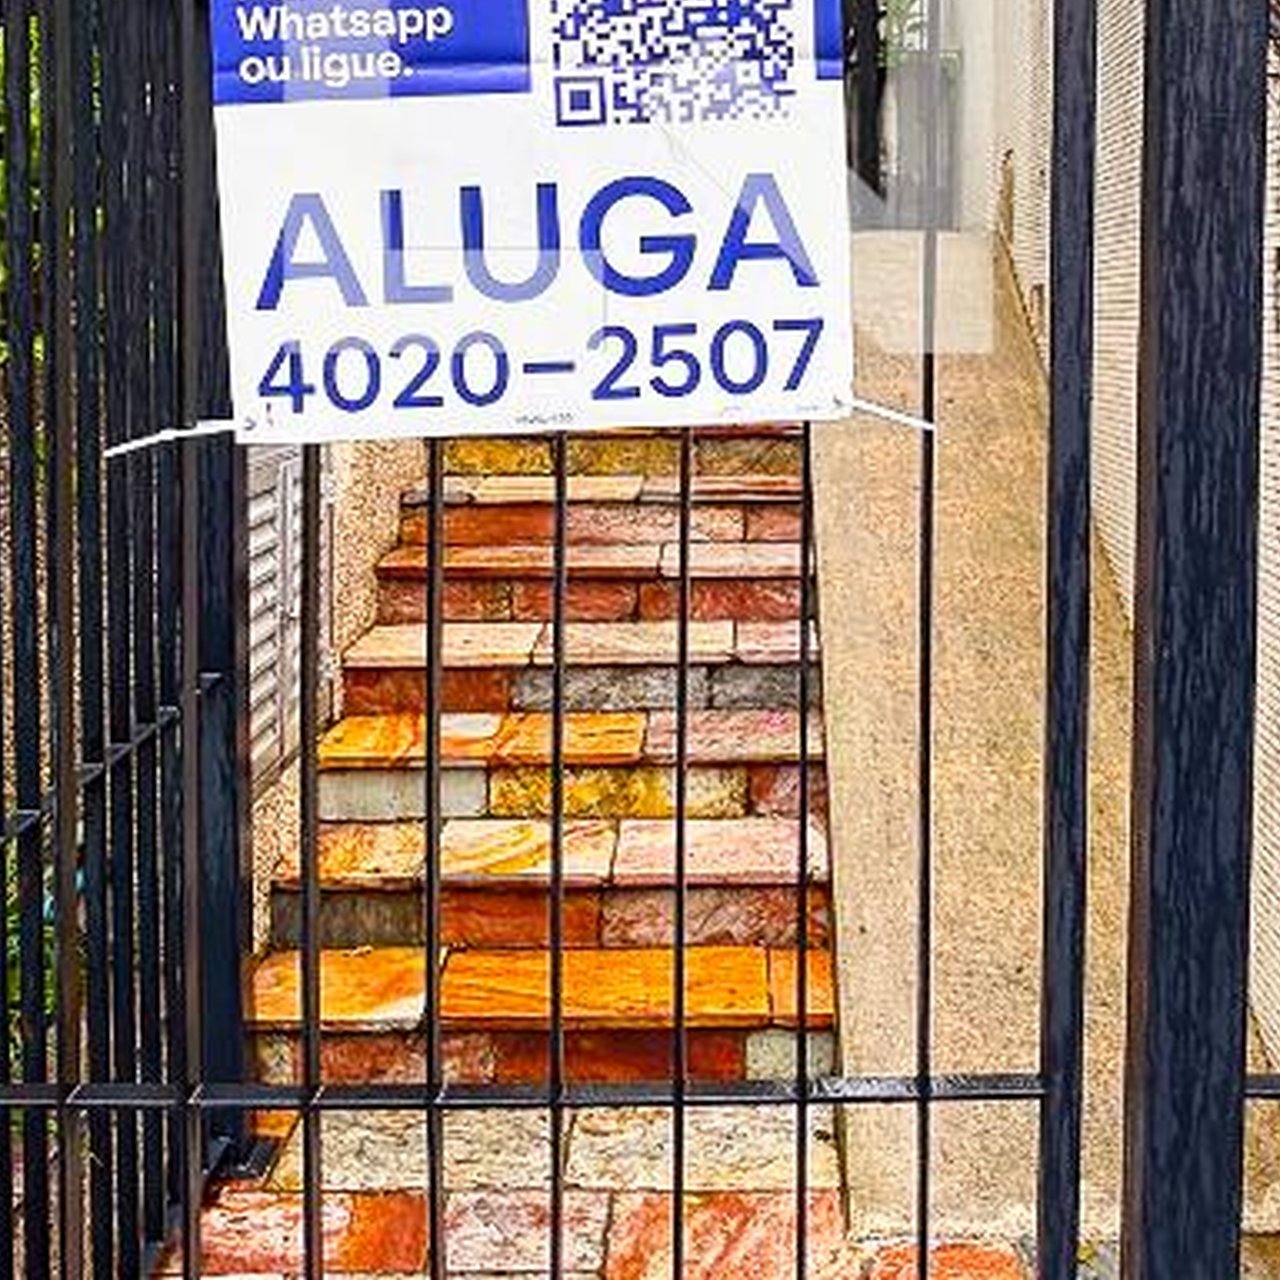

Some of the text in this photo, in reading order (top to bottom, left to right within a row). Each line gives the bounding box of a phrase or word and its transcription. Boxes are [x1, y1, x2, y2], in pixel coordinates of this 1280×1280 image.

[237, 4, 453, 43] Whatsapp
[239, 47, 414, 87] ou ligue.
[254, 172, 822, 312] ALUGA
[257, 317, 824, 414] 4020-2507
